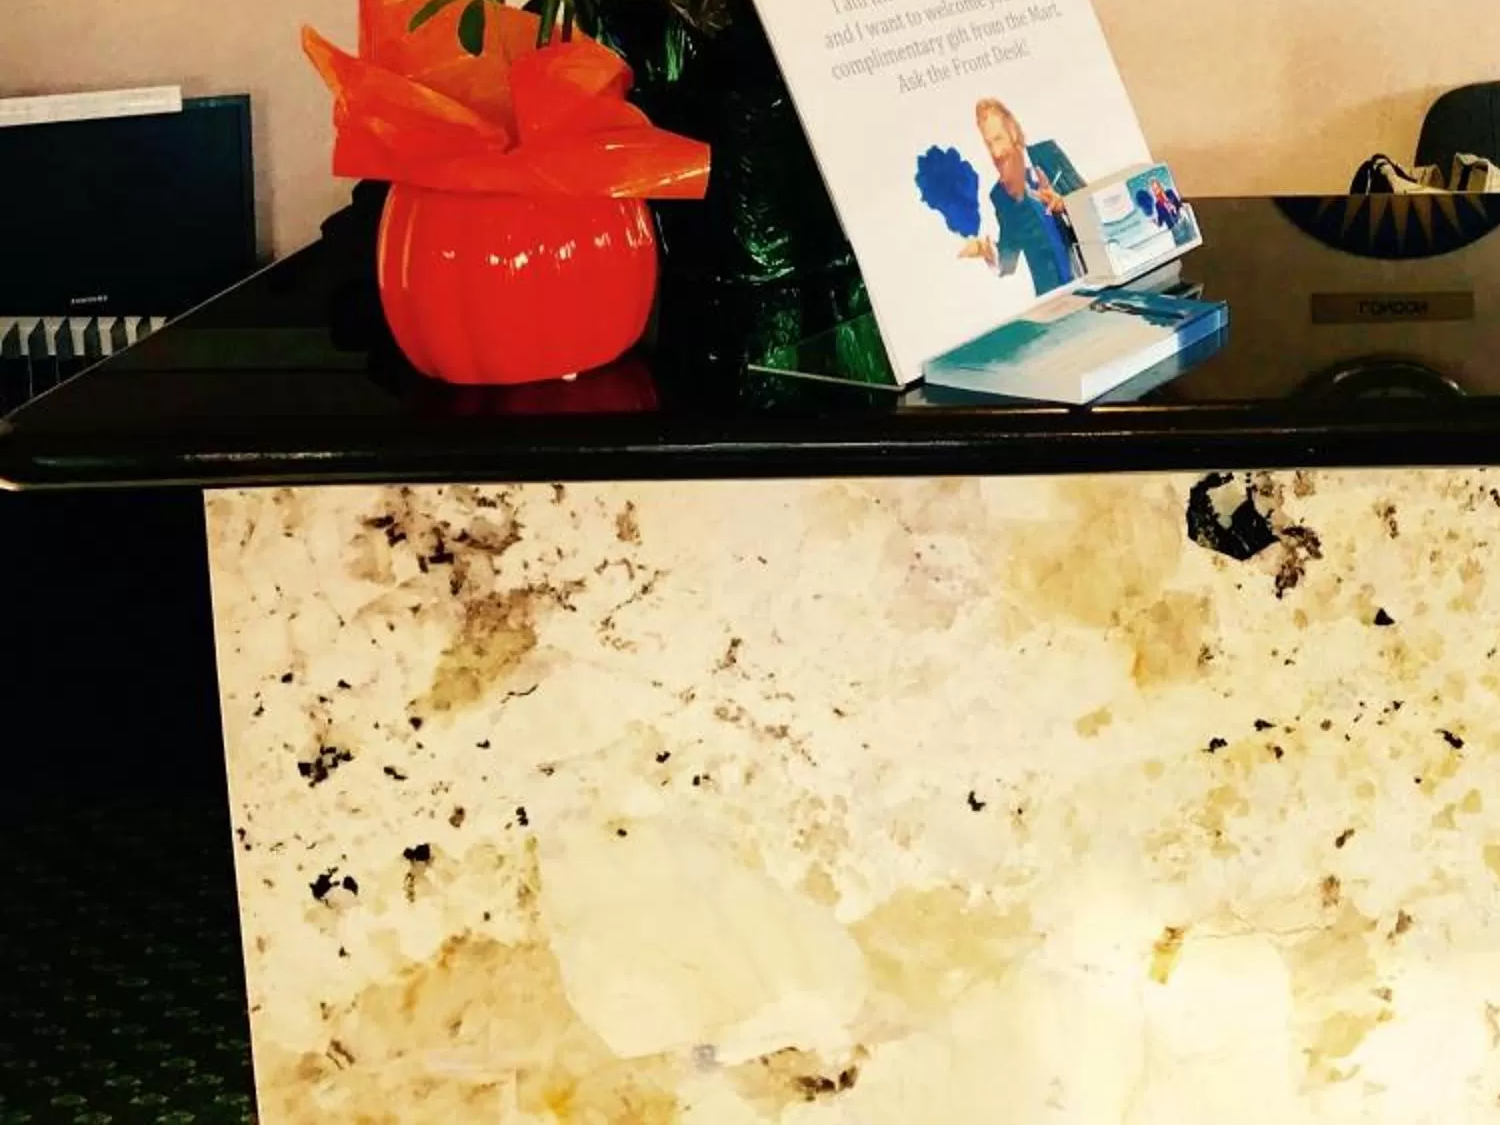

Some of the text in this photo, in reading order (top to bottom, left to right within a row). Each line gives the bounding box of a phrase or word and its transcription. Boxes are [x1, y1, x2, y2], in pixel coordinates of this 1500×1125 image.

[825, 22, 854, 49] and
[854, 20, 864, 41] I
[864, 13, 906, 40] want
[904, 9, 922, 28] to
[831, 34, 945, 81] complimentary
[946, 25, 972, 52] gift
[970, 18, 1005, 42] from
[1004, 10, 1029, 29] the
[898, 70, 927, 94] Ask
[926, 63, 952, 84] the
[951, 51, 993, 76] Front
